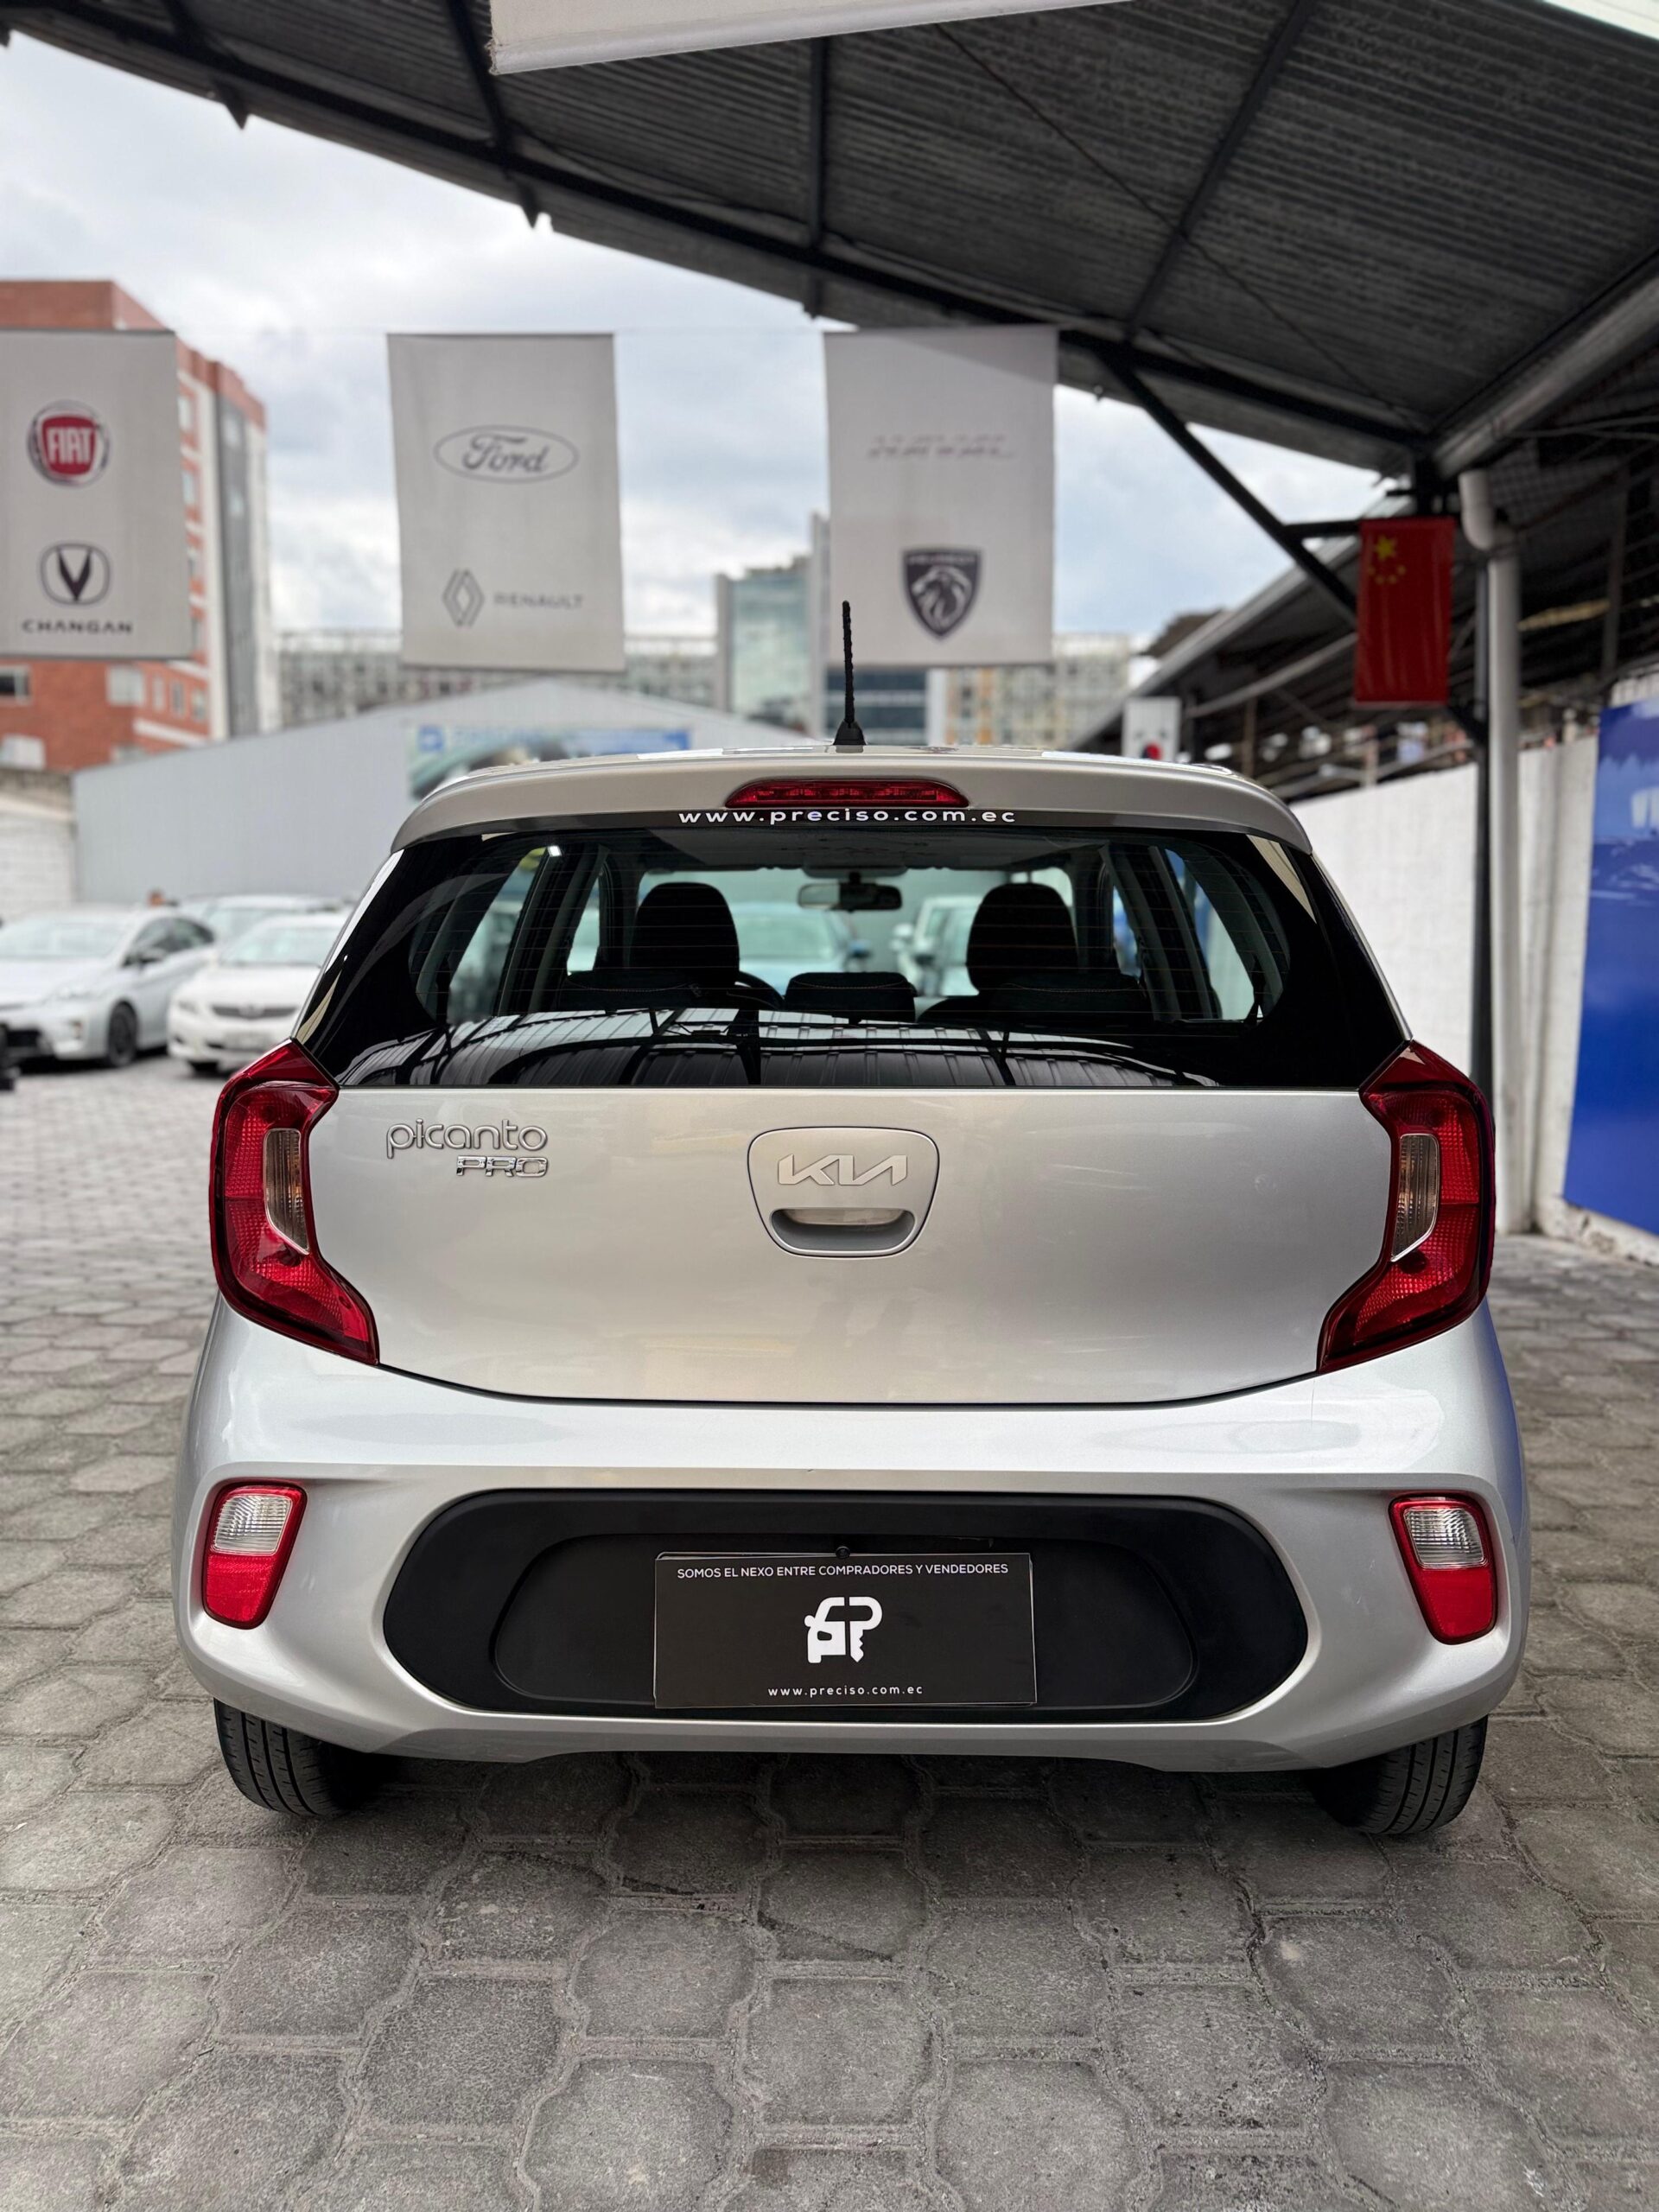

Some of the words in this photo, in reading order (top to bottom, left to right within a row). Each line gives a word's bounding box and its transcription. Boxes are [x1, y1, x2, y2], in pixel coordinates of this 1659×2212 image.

[46, 427, 95, 464] FIAT
[462, 434, 550, 473] Ford
[21, 619, 134, 634] CHANGAN
[678, 808, 1016, 825] www.preciso.com.ec
[387, 1118, 548, 1159] picanto
[455, 1154, 548, 1177] PRO
[779, 1154, 907, 1185] KIA
[677, 1567, 721, 1579] SOMOS
[724, 1567, 739, 1578] EL
[741, 1567, 774, 1577] NEXO
[777, 1566, 816, 1576] ENTRE
[818, 1565, 913, 1575] COMPRADORES
[915, 1565, 924, 1574] Y
[925, 1564, 1008, 1574] VENDEDORES
[767, 1685, 924, 1698] www.preciso.com.ec
